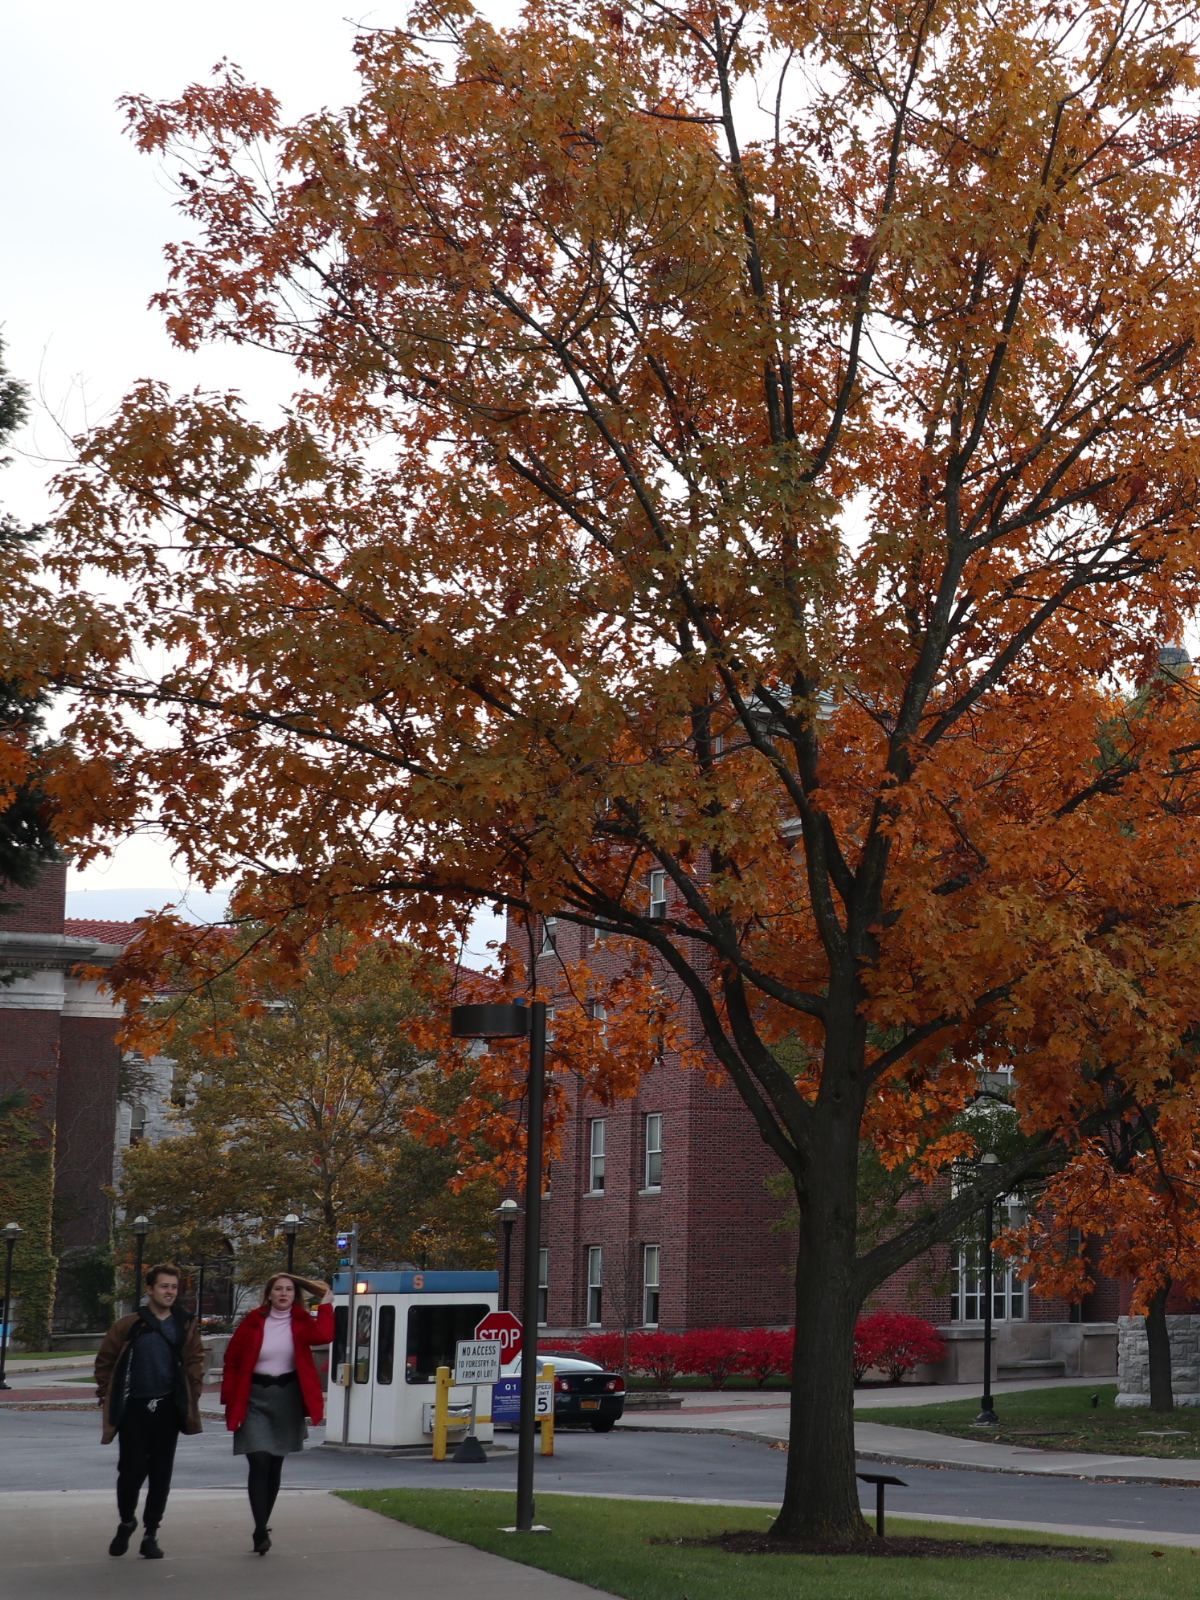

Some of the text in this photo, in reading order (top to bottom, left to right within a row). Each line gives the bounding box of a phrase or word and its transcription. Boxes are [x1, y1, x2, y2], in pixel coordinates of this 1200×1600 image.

[413, 1274, 424, 1289] S
[479, 1329, 520, 1348] STOP
[462, 1345, 496, 1356] NO ACCESS
[458, 1360, 465, 1368] TO
[466, 1359, 490, 1368] FORESTRY
[484, 1370, 493, 1378] LOT
[537, 1397, 548, 1412] 5
